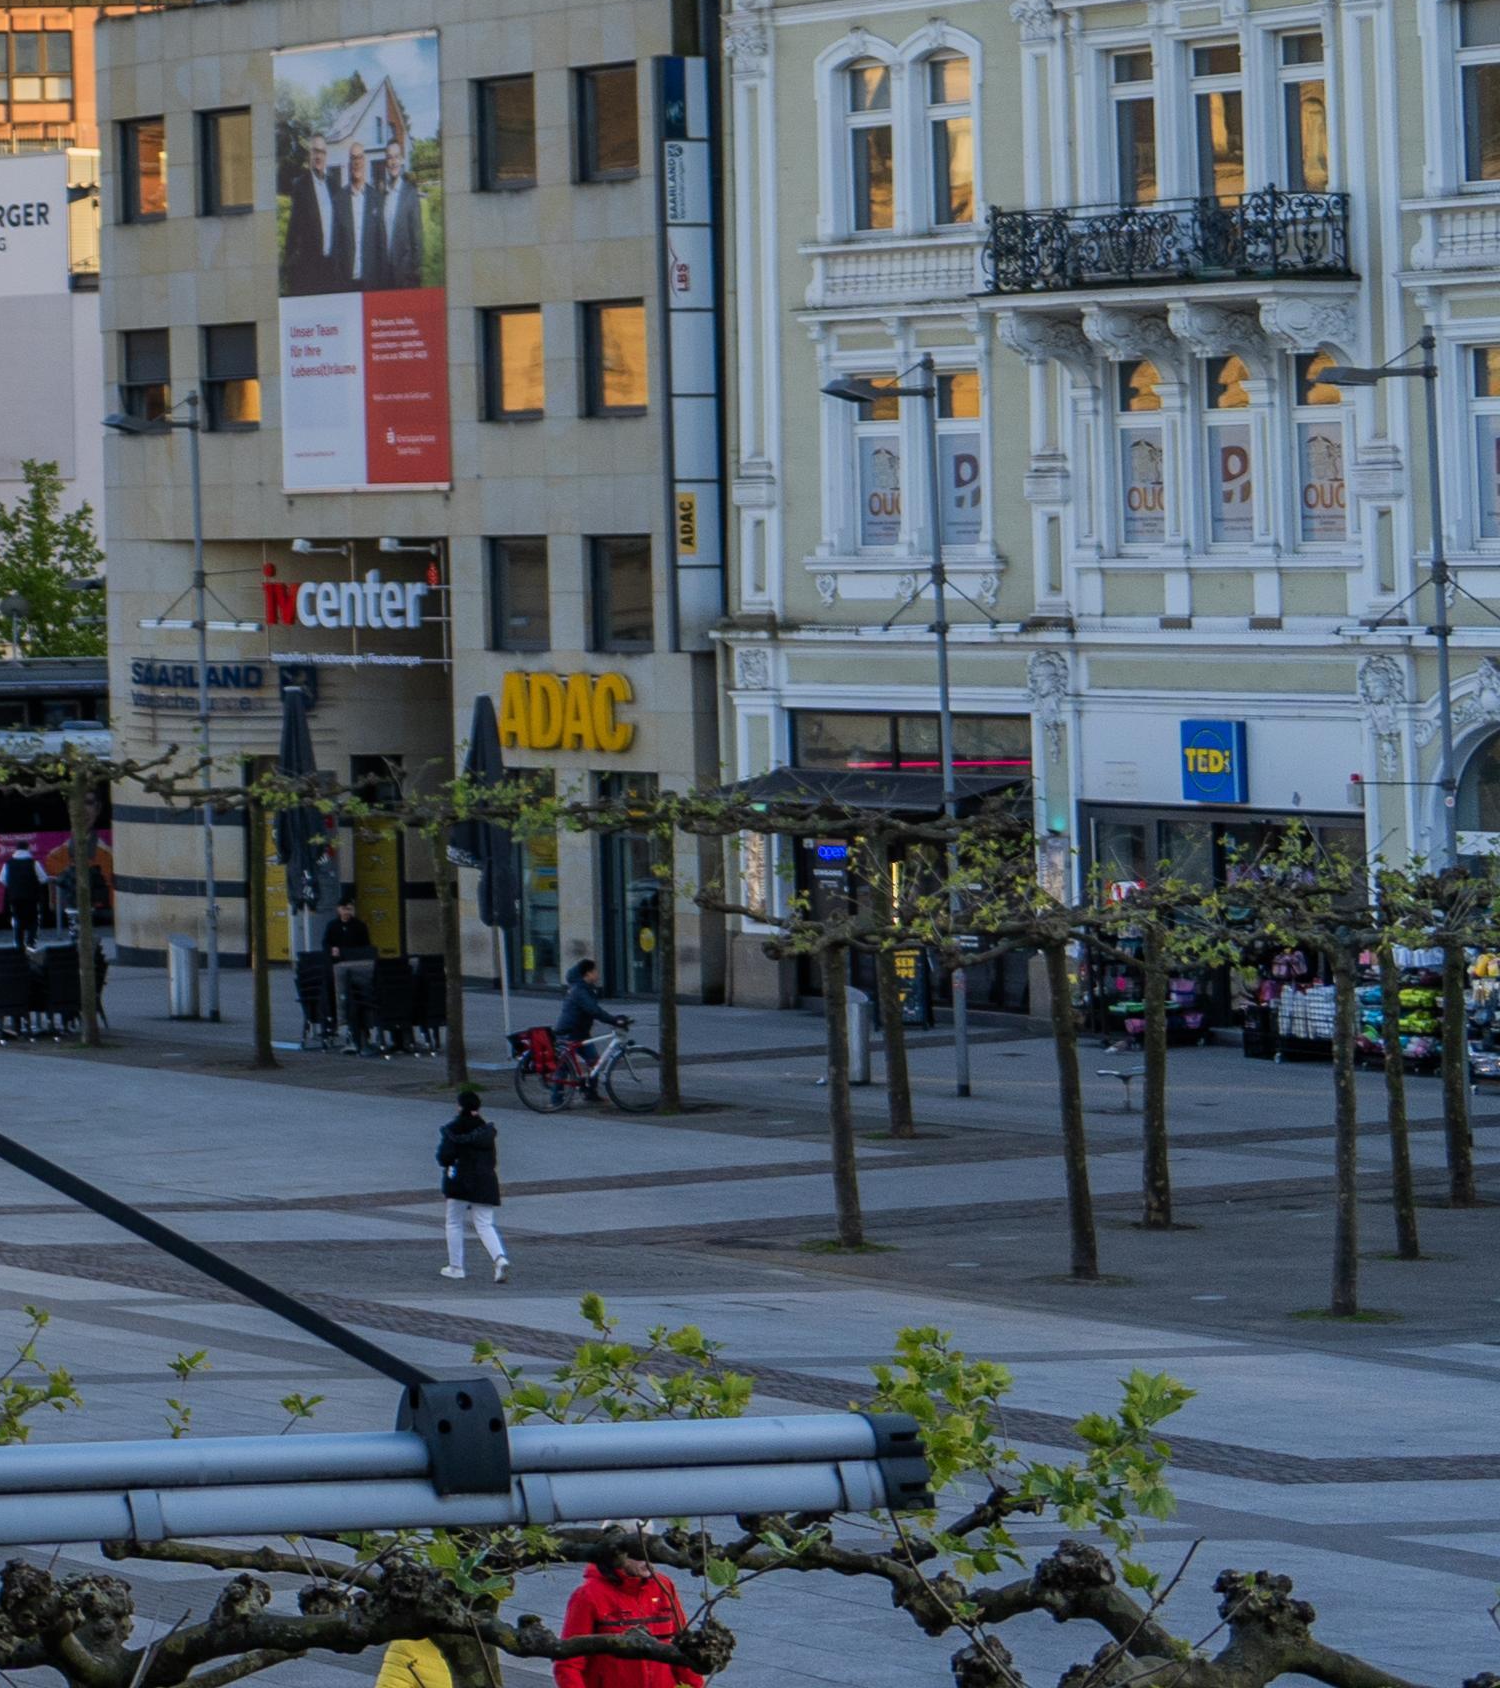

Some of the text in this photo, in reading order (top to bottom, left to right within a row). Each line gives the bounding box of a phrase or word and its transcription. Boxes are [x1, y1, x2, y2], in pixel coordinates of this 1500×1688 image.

[676, 263, 691, 292] LBS
[291, 324, 339, 338] Unser Team
[679, 500, 694, 548] ADAC
[131, 662, 264, 689] SAARLAND
[499, 670, 635, 753] ADAC
